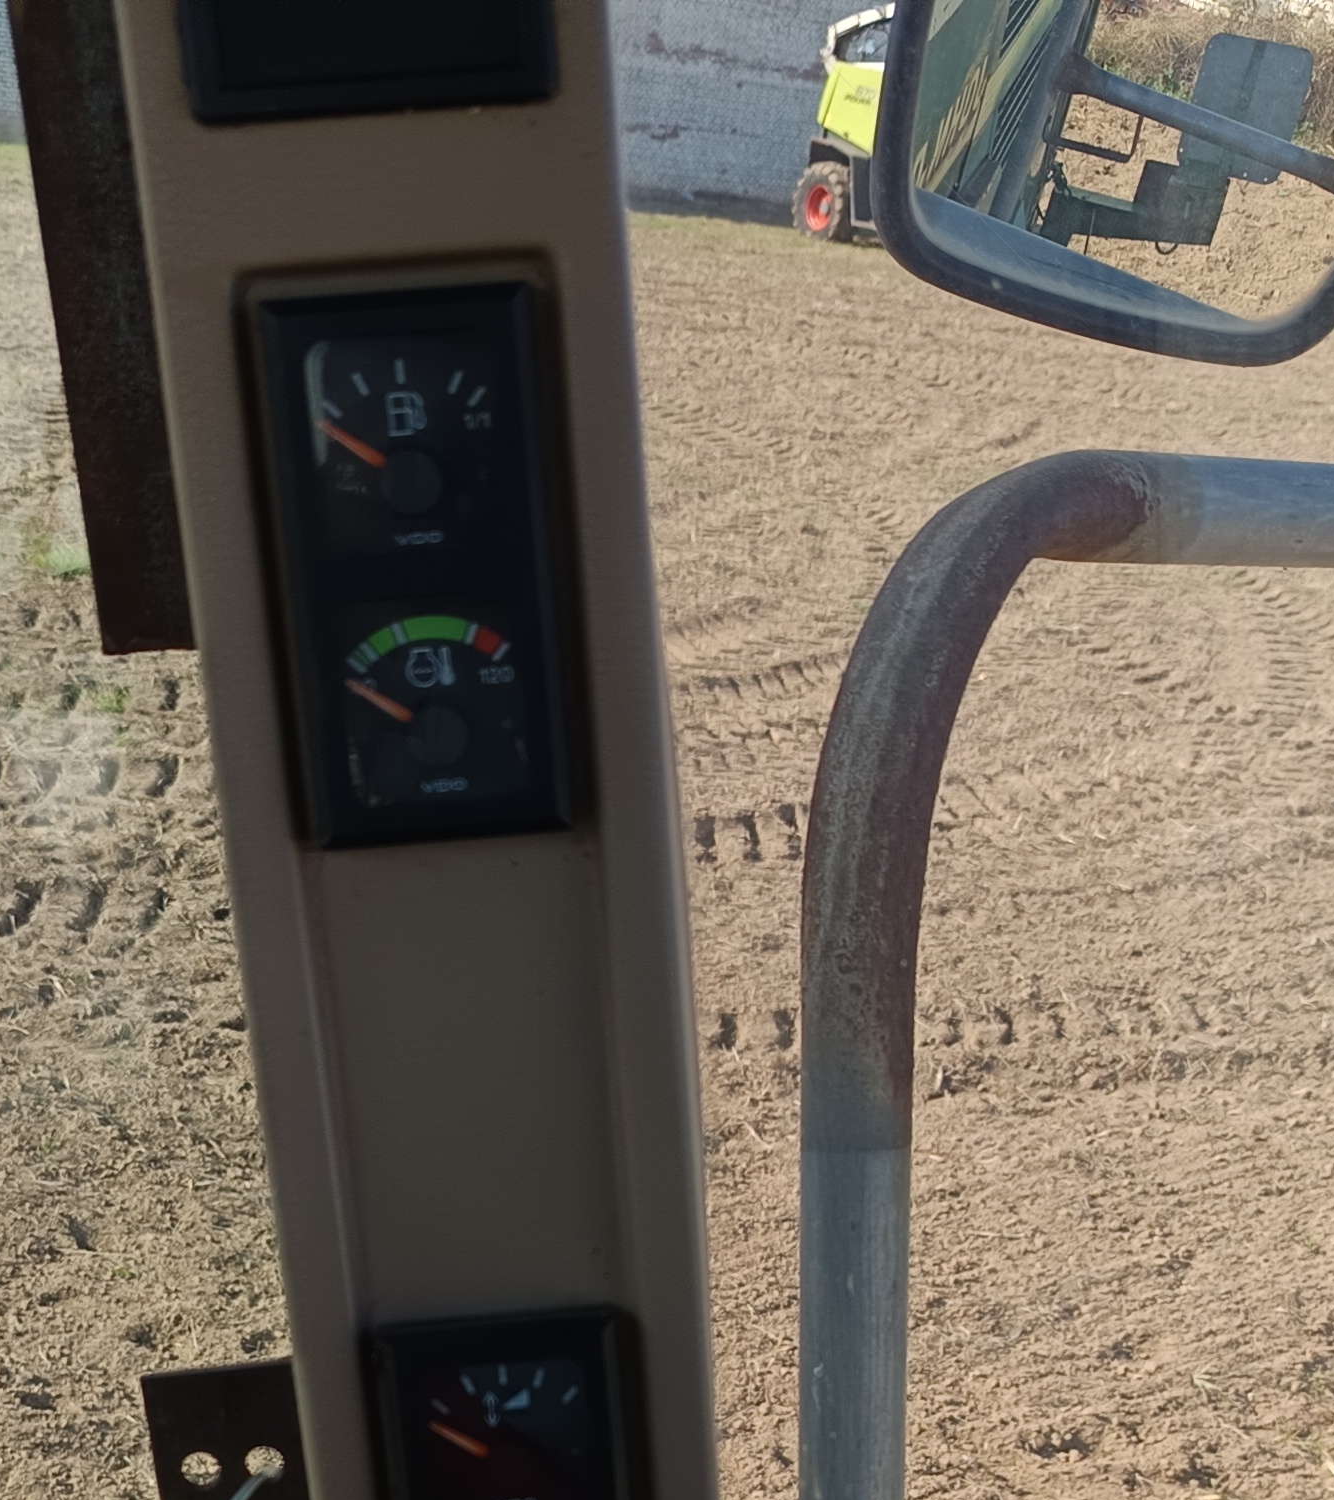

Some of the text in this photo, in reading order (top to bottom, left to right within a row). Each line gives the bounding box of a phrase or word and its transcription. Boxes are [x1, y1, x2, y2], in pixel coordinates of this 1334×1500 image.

[394, 528, 445, 547] VDO
[476, 664, 516, 685] 120
[419, 776, 470, 795] VDO
